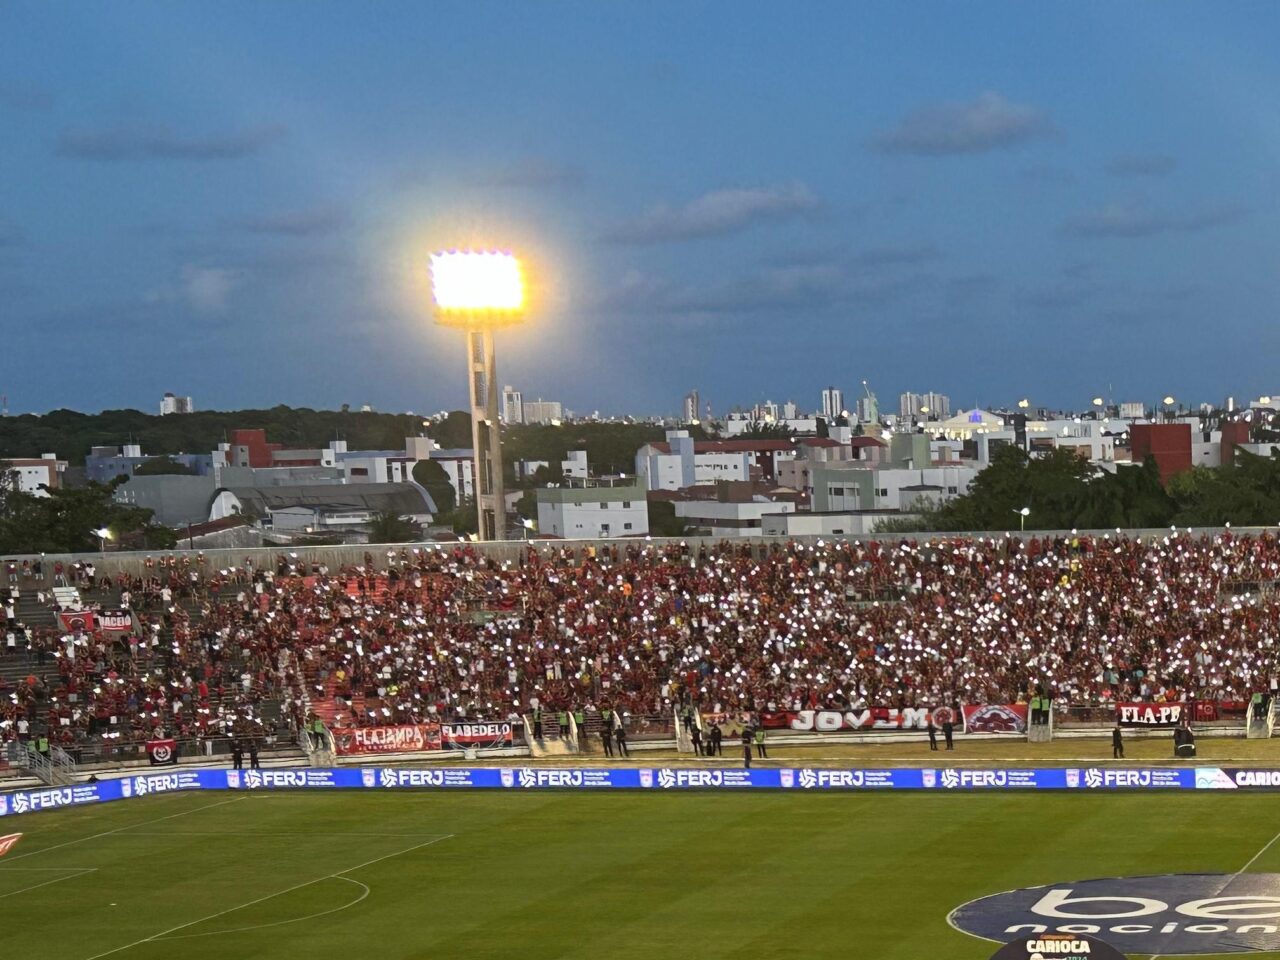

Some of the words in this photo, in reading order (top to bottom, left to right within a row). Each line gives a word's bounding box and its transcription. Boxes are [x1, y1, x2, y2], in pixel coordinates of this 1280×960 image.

[442, 723, 511, 737] FLABEDELO
[148, 774, 178, 791] FERJ
[262, 771, 306, 786] FERJ
[399, 771, 443, 786] FERJ
[537, 771, 582, 786] FERJ
[677, 771, 722, 786] FERJ
[818, 771, 864, 786] FERJ
[961, 771, 1007, 786] FERJ
[1104, 771, 1151, 786] FERJ
[30, 789, 73, 809] FERJ
[1026, 939, 1091, 953] CARIOCA
